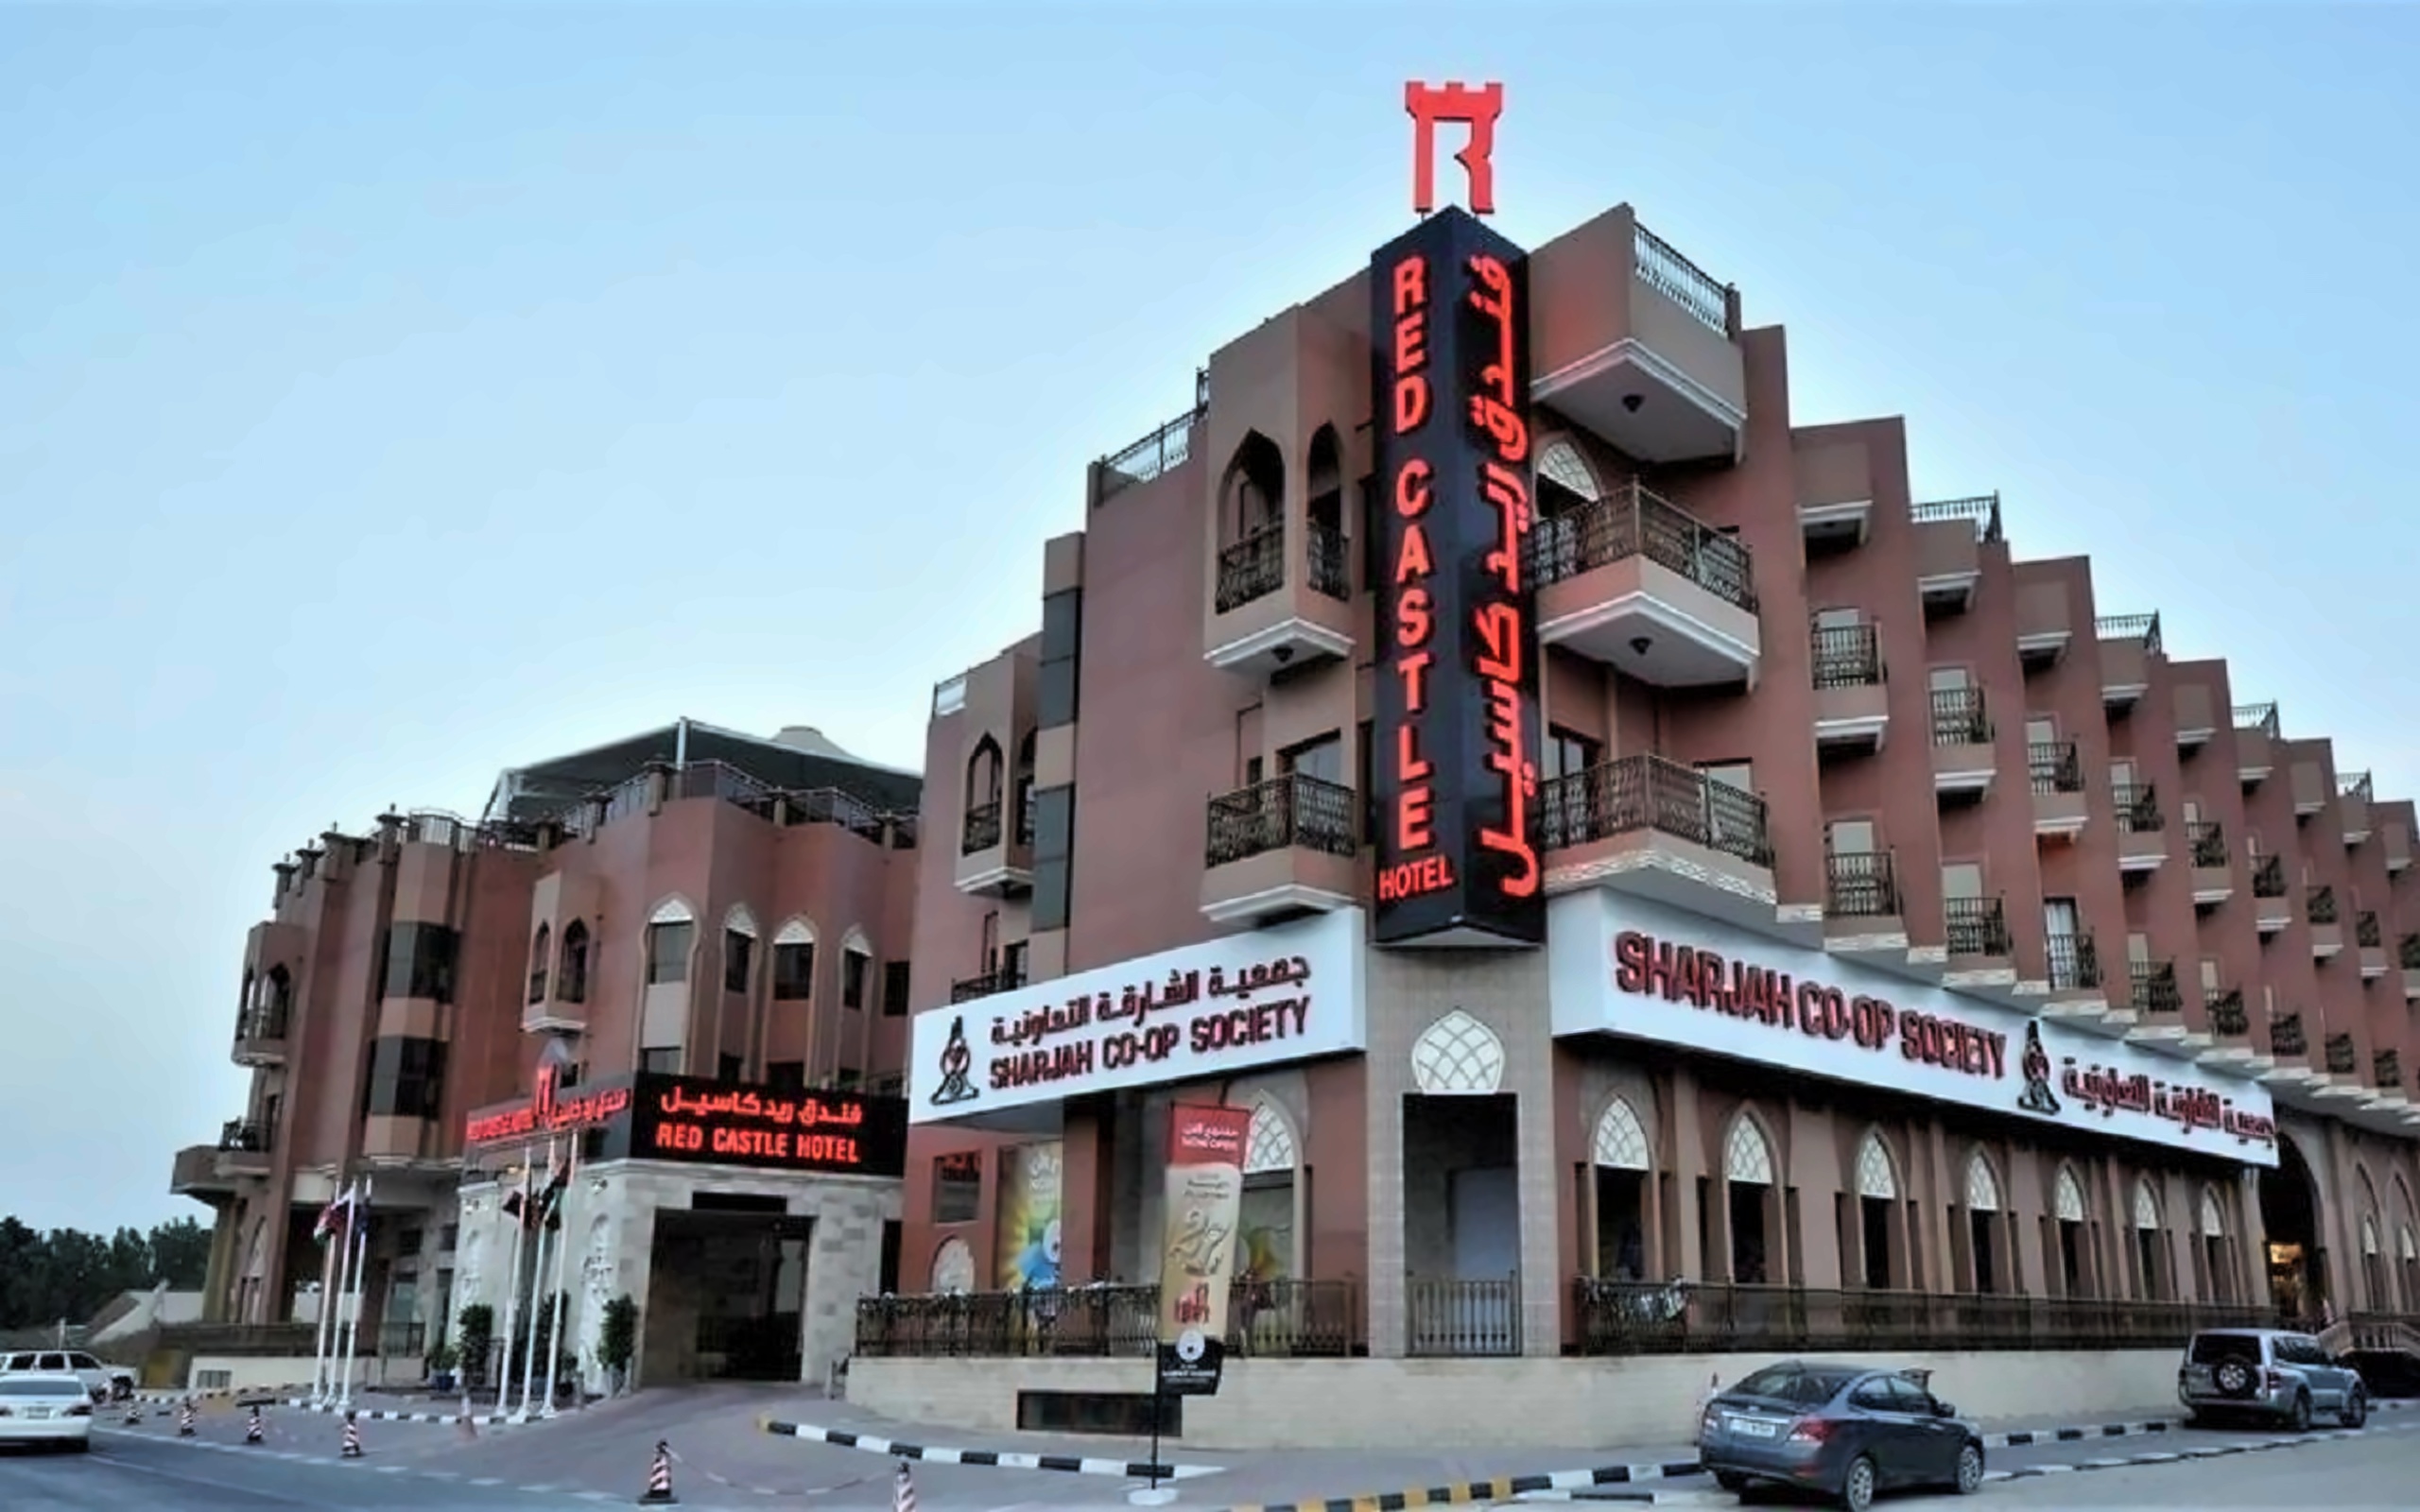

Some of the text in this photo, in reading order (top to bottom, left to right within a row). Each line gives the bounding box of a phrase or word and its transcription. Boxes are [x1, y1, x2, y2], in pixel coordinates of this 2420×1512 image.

[1470, 255, 1528, 461] فندق
[1394, 256, 1430, 850] RED CASTLE
[1379, 856, 1452, 901] HOTEL
[990, 955, 1311, 1047] جمعية الشارقة التعاونية
[990, 995, 1311, 1090] SHARJAH CO-OP SOCIETY
[1616, 931, 2007, 1079] SHARJAH CO-OP SOCIETY
[656, 1122, 860, 1163] RED CASTLE HOTEL
[798, 1098, 863, 1127] فندق
